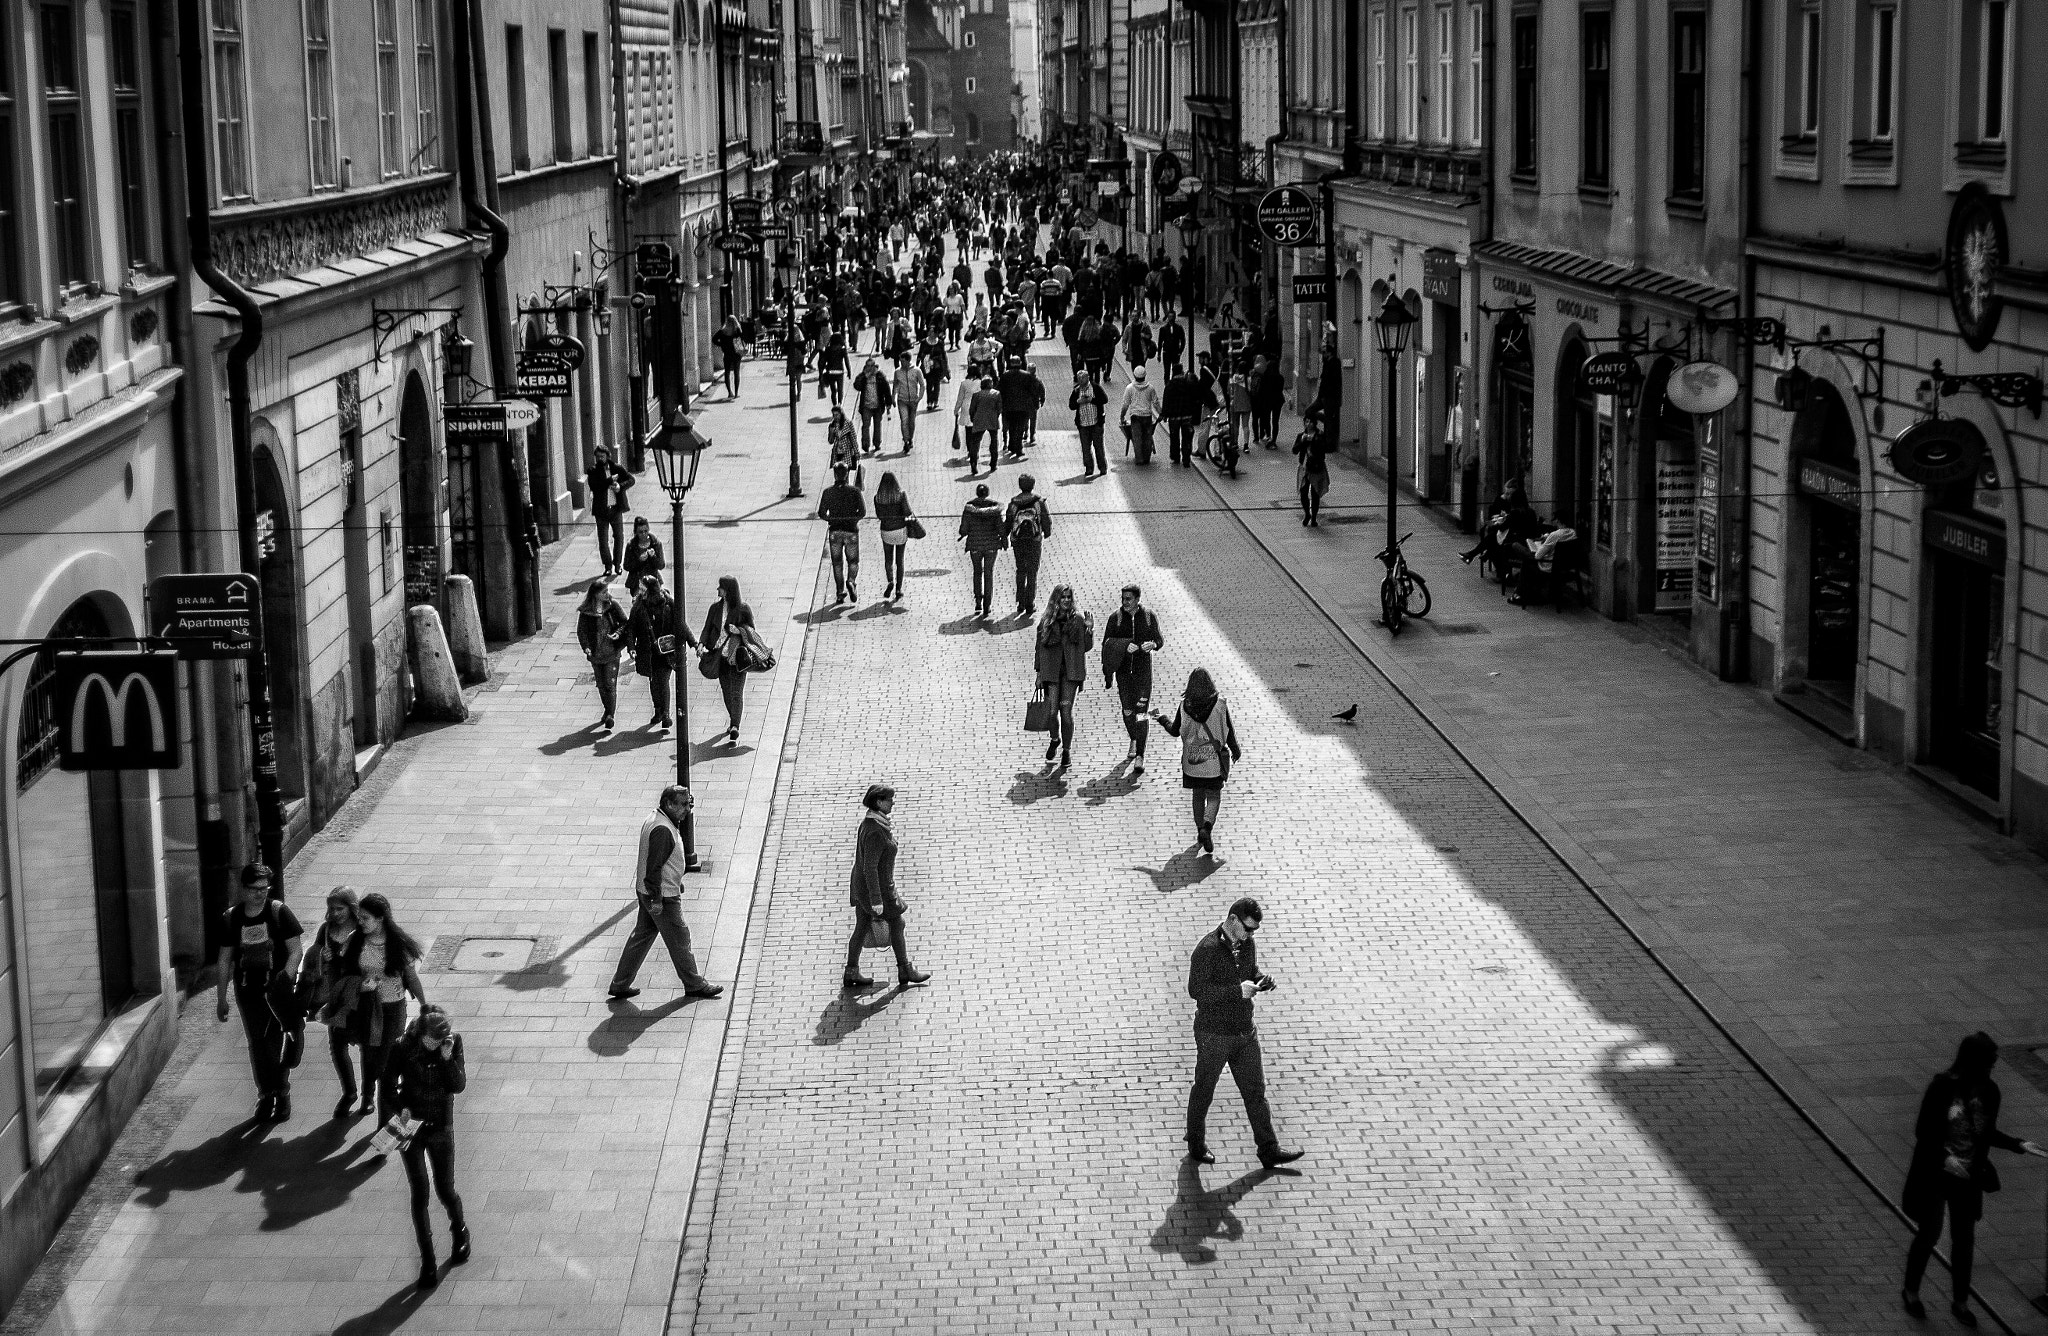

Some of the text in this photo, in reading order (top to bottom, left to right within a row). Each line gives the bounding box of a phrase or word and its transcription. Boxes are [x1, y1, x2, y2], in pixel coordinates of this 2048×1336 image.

[1276, 206, 1310, 214] GALLERY
[1274, 223, 1300, 241] 36
[1556, 298, 1598, 323] CHOCOLATE
[1588, 362, 1628, 374] KANTO
[518, 374, 568, 387] KEBAB
[1658, 509, 1676, 518] Salt
[1942, 525, 1988, 557] JUBILER
[177, 597, 216, 605] BRAMA
[178, 616, 251, 631] Apartments
